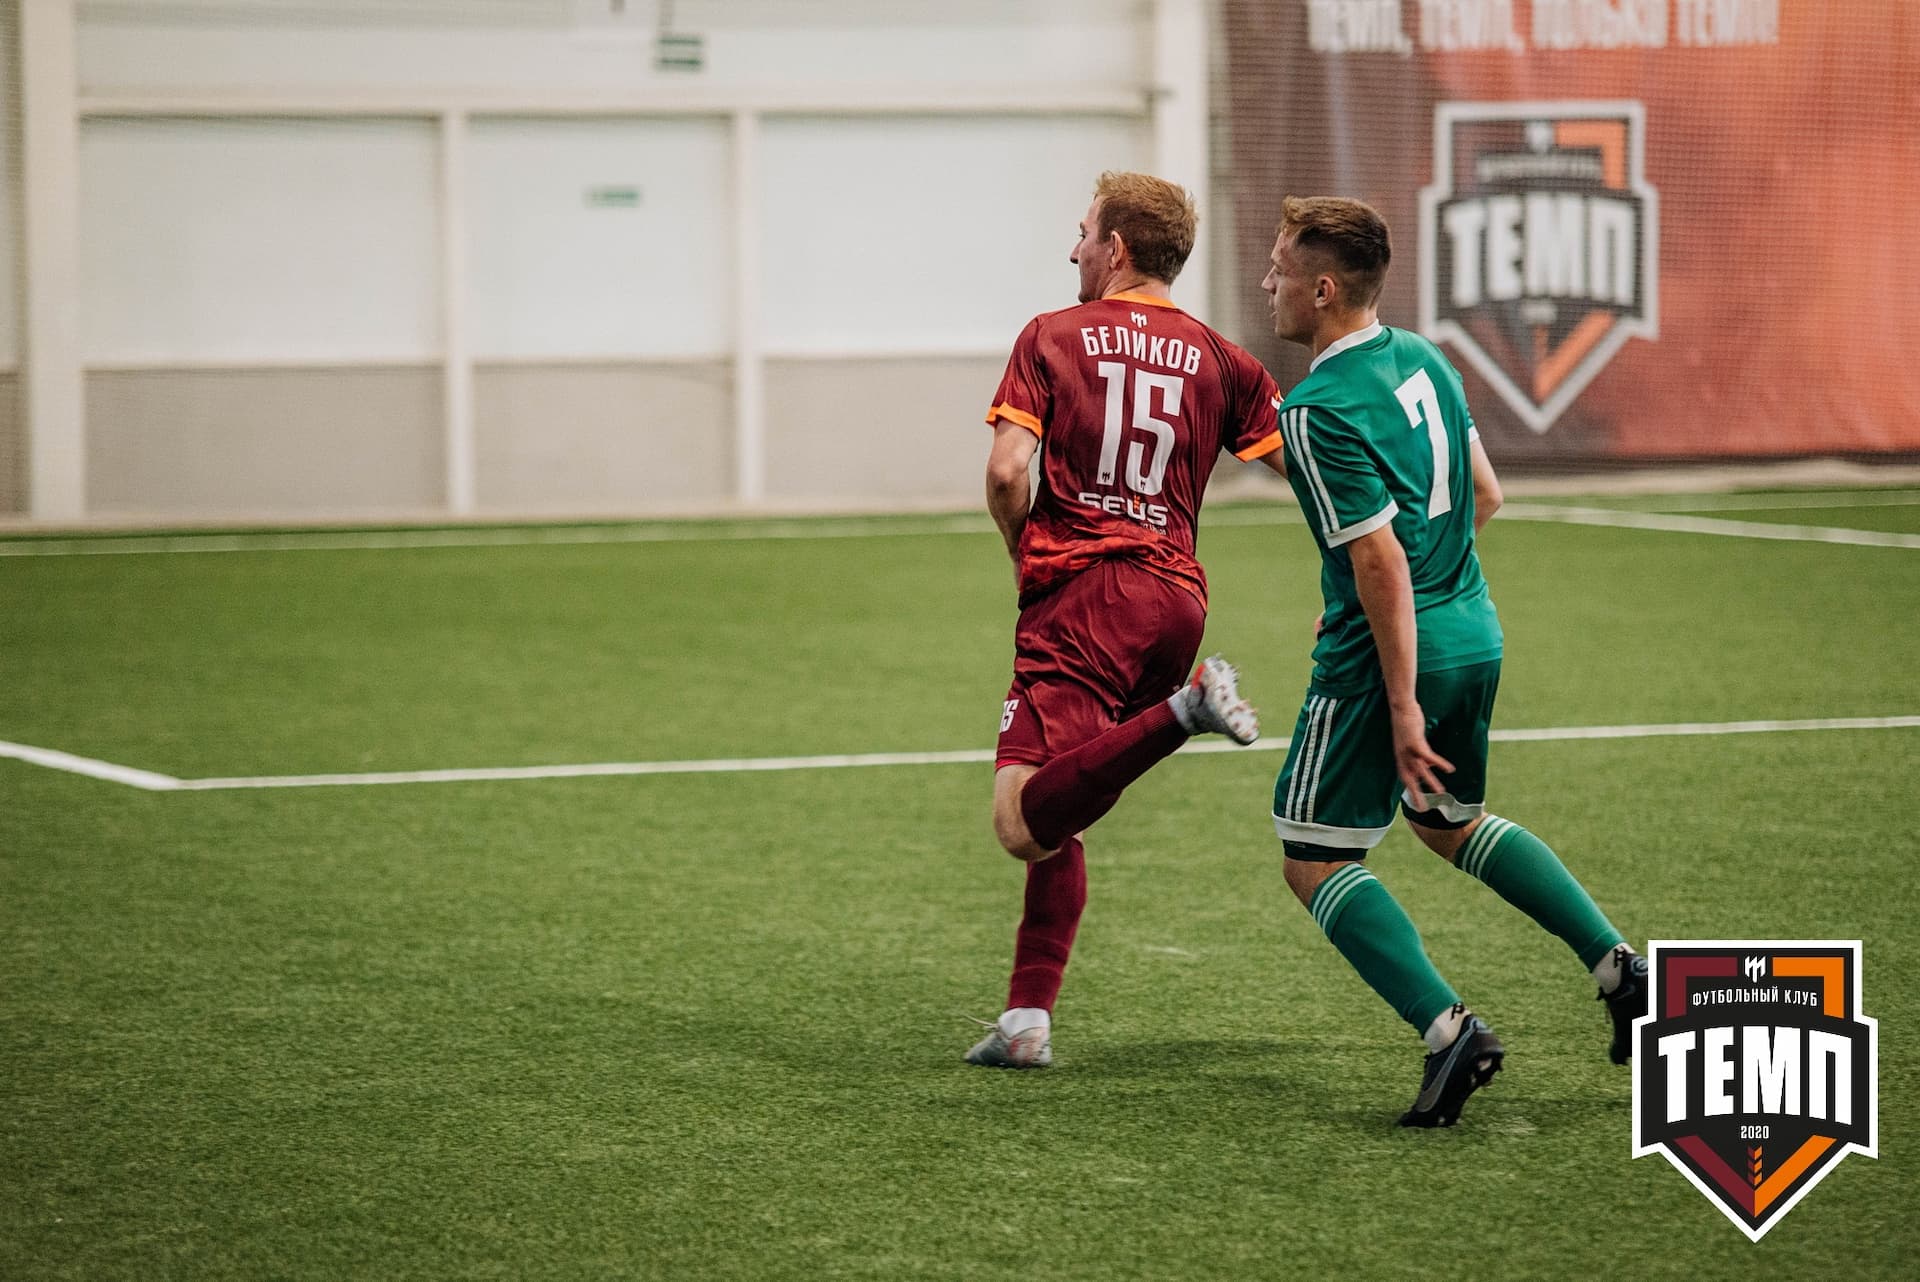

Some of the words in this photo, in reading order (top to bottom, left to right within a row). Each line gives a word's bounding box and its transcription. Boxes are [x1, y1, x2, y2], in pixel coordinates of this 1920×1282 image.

[1443, 192, 1636, 308] ТЕМП
[1080, 326, 1202, 376] БЕЛИКОВ
[1096, 361, 1185, 496] 15
[1393, 367, 1452, 521] 7
